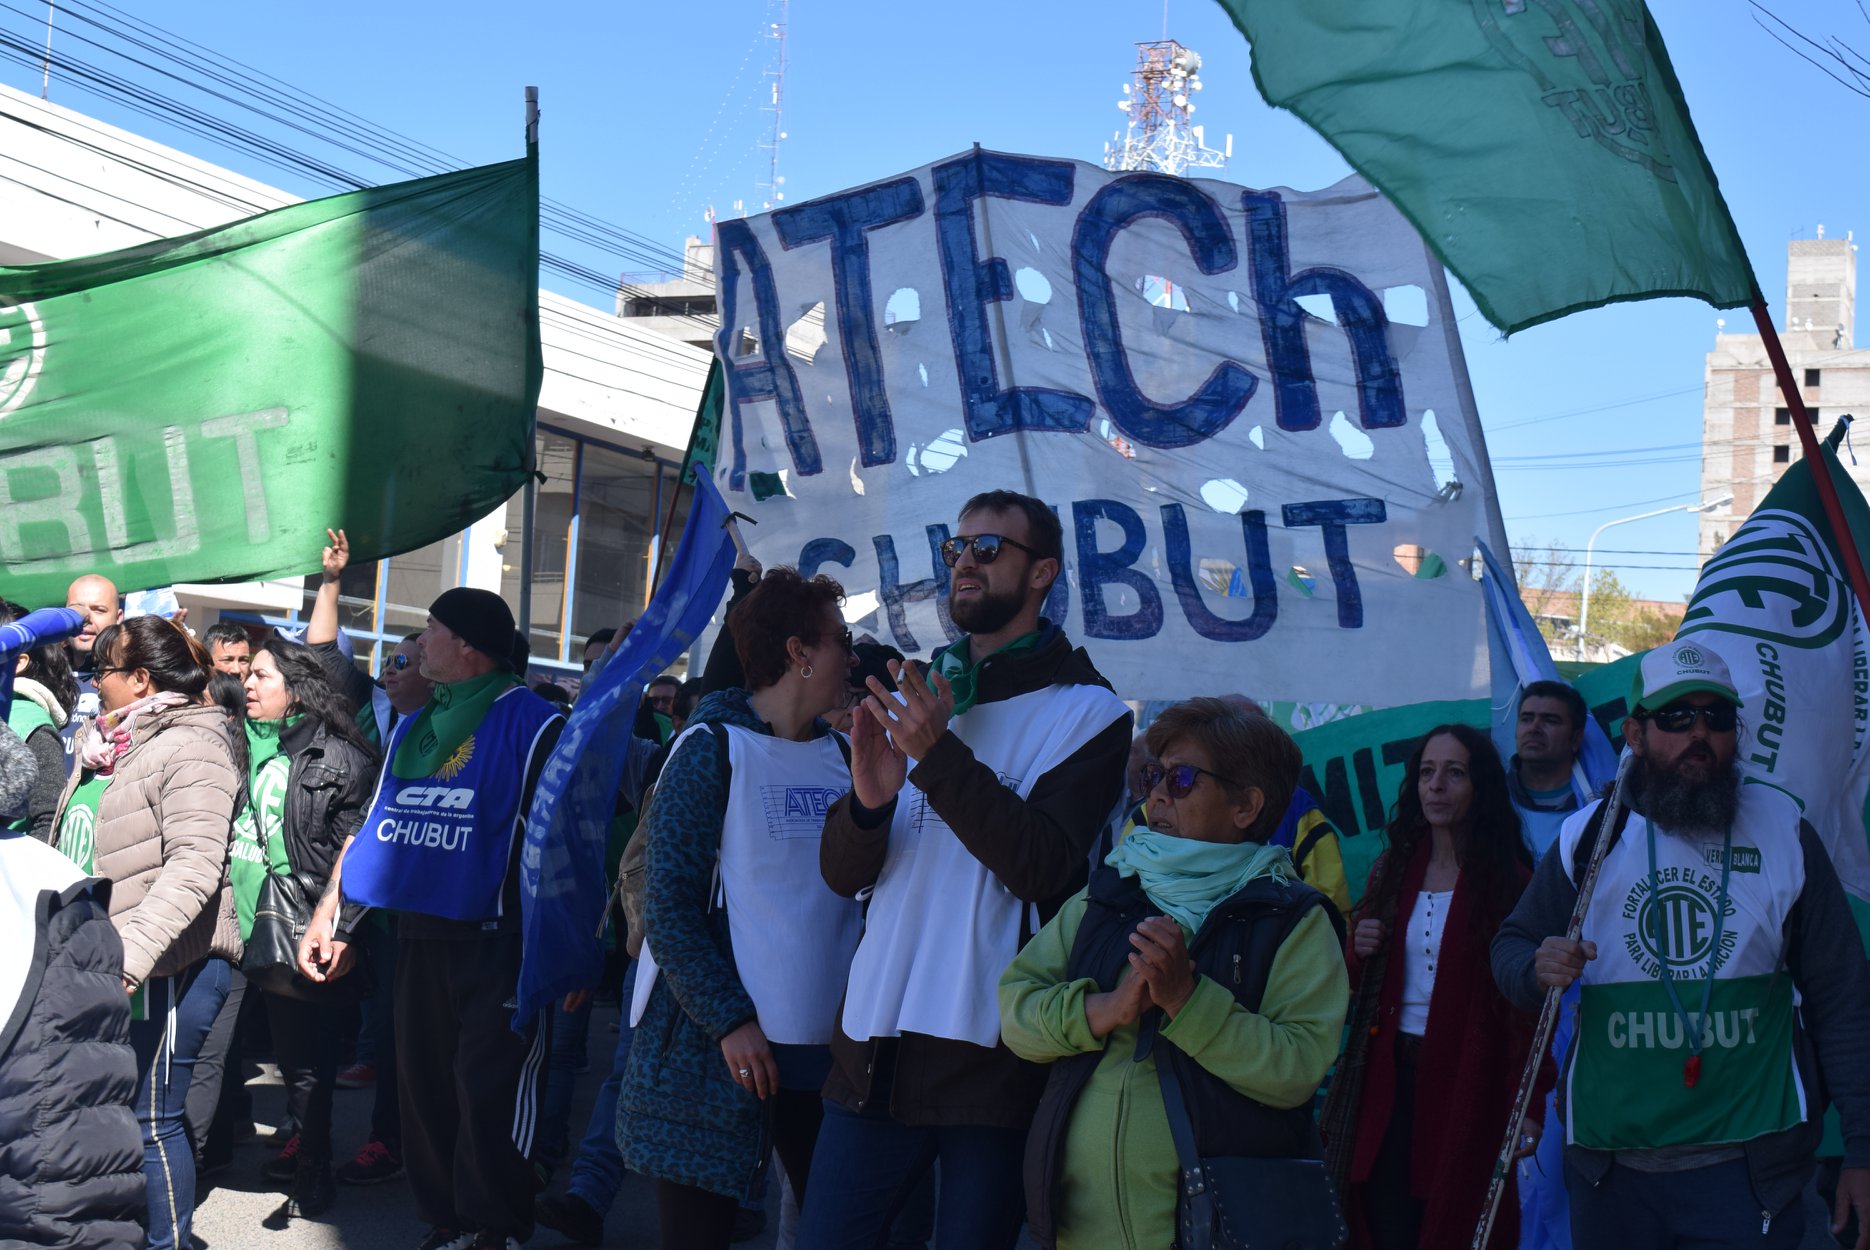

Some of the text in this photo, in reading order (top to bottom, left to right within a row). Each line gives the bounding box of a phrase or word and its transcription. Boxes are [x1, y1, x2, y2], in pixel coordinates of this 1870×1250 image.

[798, 498, 1387, 653] HBUT
[1676, 668, 1711, 676] CHUBUT
[1750, 642, 1786, 774] CHUBUT
[396, 786, 475, 809] CTA
[785, 788, 846, 816] ATEC
[376, 818, 473, 851] CHUBUT
[1706, 848, 1759, 868] VERD BLANCA
[1622, 866, 1679, 920] FORTALCER
[1682, 867, 1696, 885] EL
[1623, 932, 1645, 964] PARA
[1640, 958, 1691, 981] LIBRAR
[1607, 1007, 1760, 1050] CHUBUT
